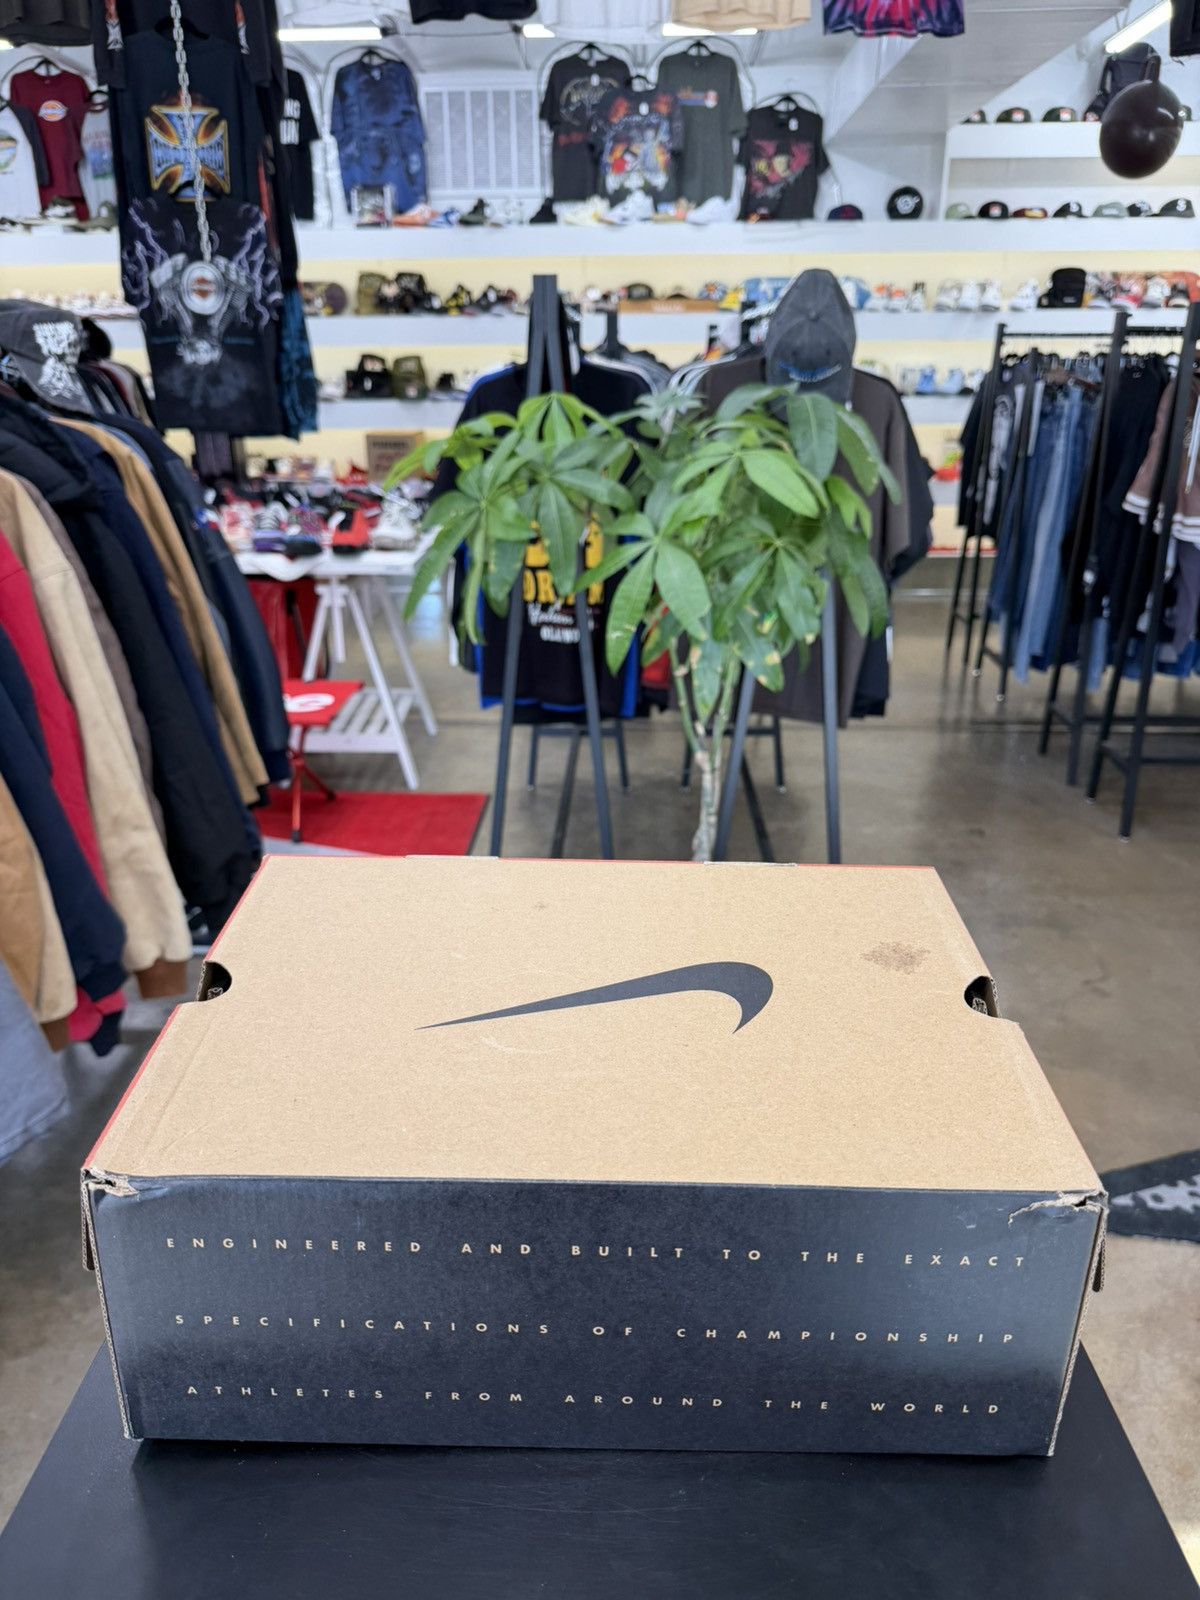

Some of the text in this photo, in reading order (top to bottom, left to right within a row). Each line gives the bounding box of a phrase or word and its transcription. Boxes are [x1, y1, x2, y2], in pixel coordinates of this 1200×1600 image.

[166, 1237, 1025, 1268] ENGINEERED AND BUILT TO THE EXACT
[175, 1314, 1014, 1344] SPECIFICATIONS OF CHAMPIONSHIP
[187, 1385, 999, 1414] ATHLETES FROM AROUND THE WORLD
